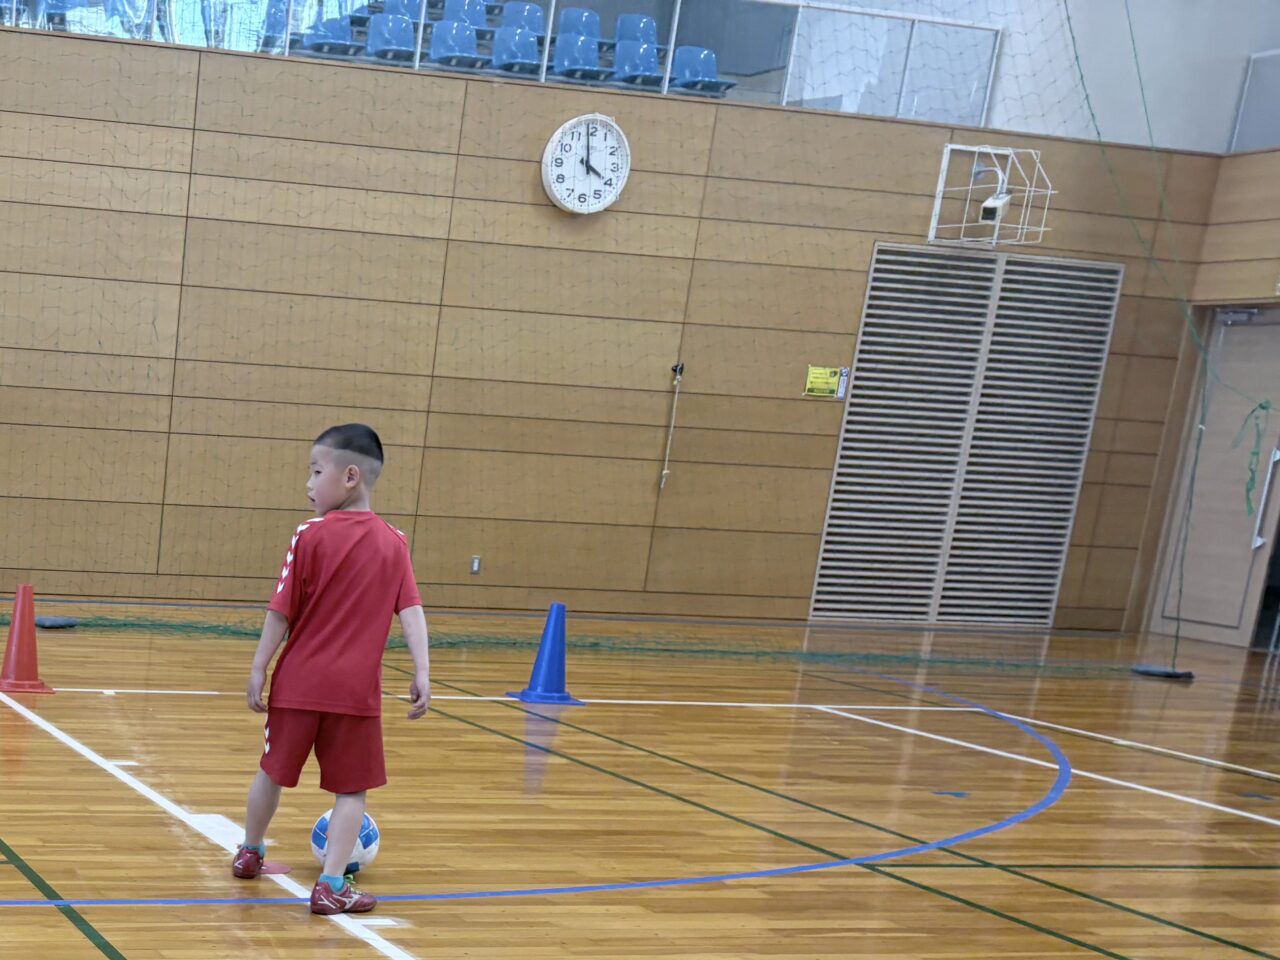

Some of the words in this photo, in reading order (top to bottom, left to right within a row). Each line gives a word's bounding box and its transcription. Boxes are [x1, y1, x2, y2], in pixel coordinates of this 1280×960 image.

[571, 131, 581, 142] 11
[560, 142, 572, 153] 10
[609, 146, 618, 156] 2
[554, 157, 564, 168] 9
[610, 162, 619, 173] 3
[556, 174, 565, 184] 8
[603, 178, 613, 187] 4
[565, 187, 575, 198] 7
[593, 189, 602, 200] 5
[578, 193, 587, 204] 6
